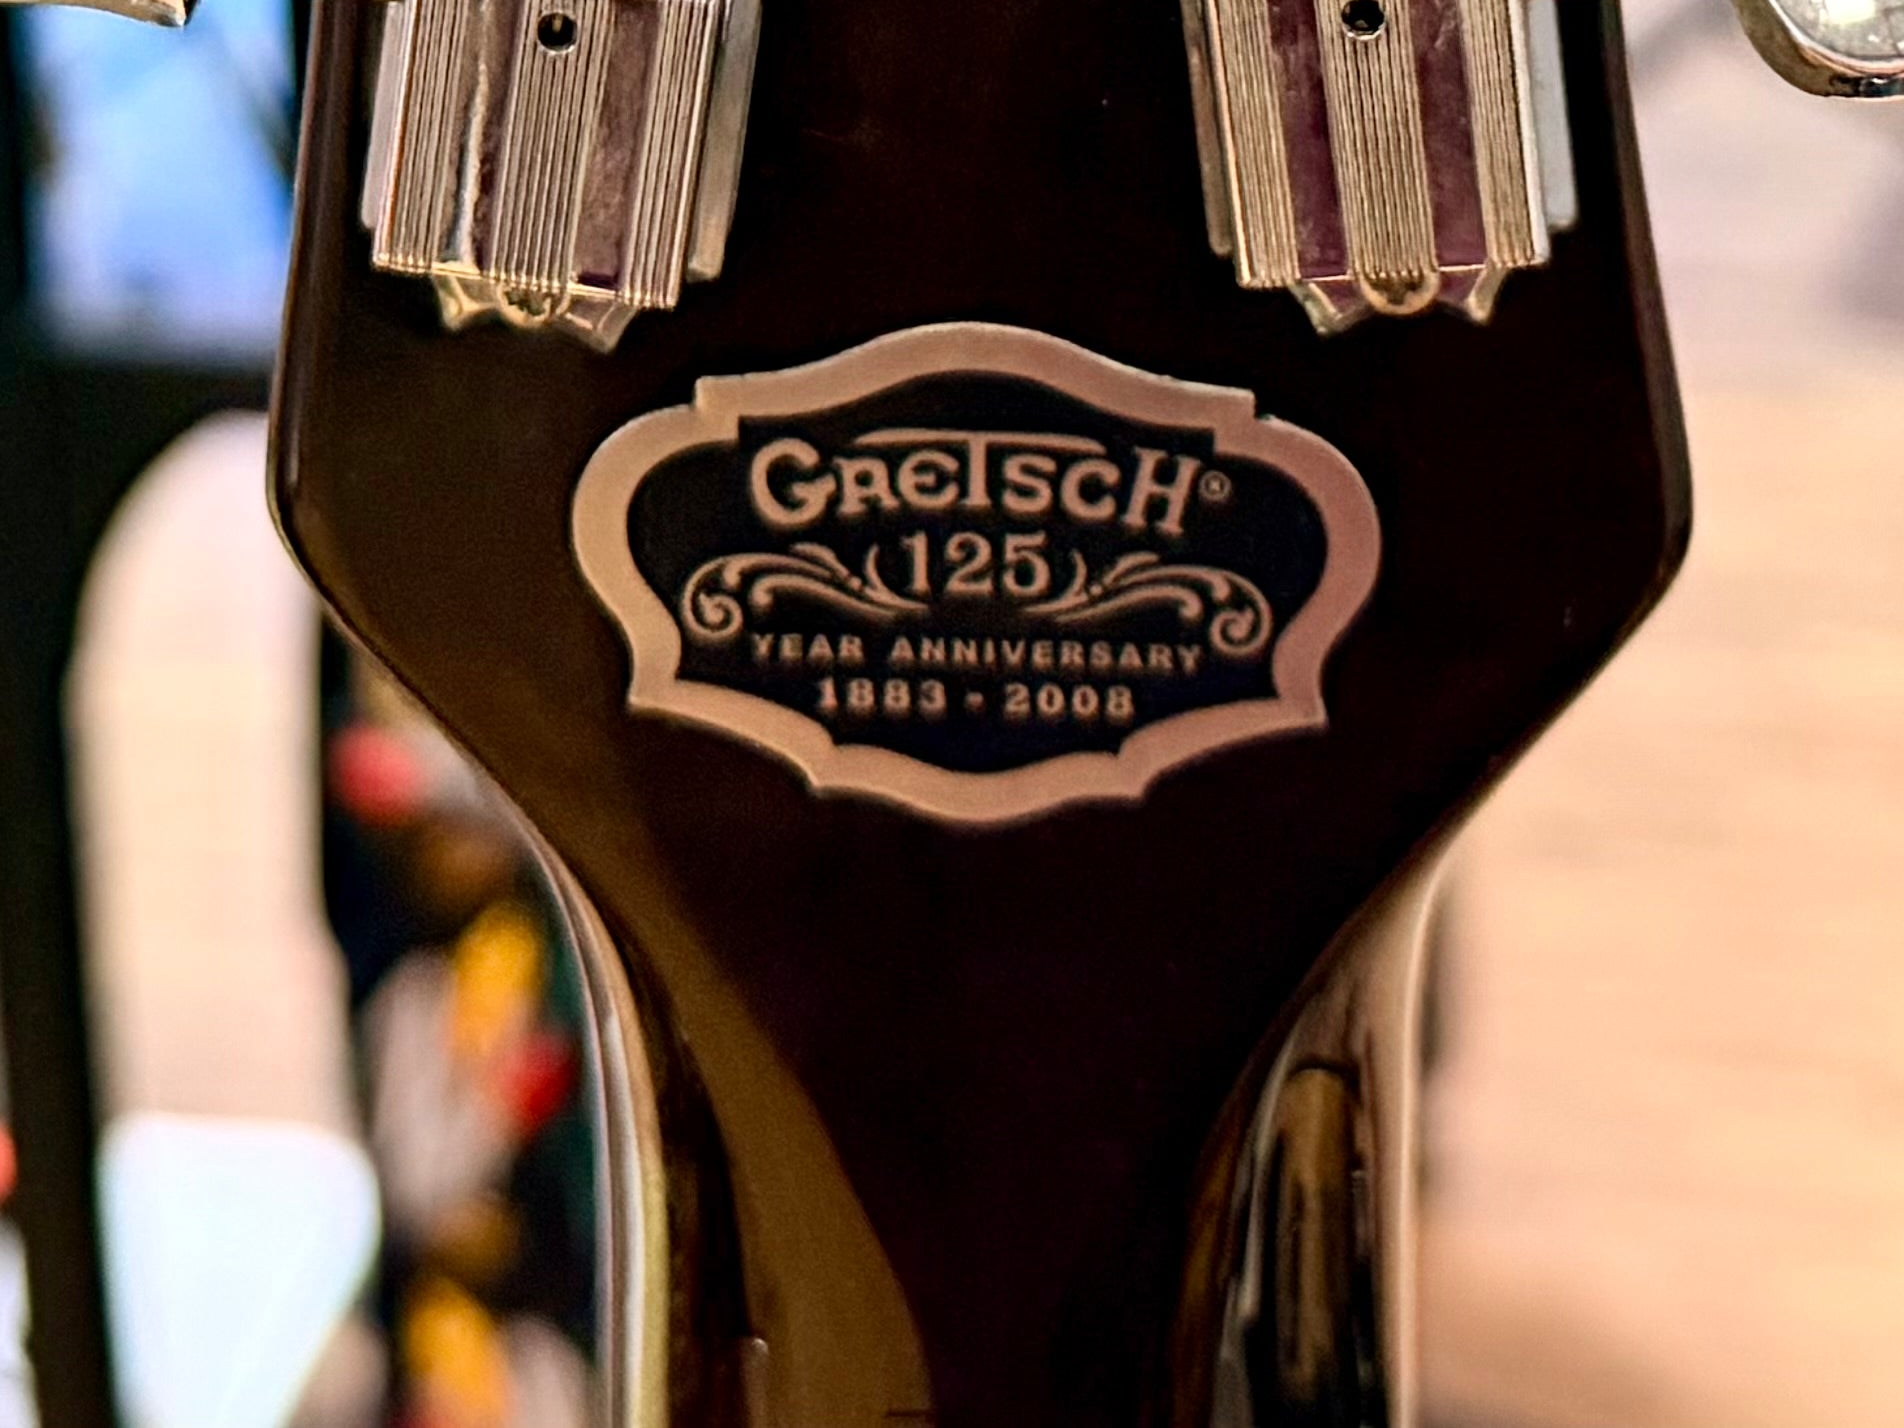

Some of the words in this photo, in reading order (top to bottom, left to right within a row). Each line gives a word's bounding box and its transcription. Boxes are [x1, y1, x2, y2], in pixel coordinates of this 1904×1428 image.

[900, 530, 1052, 597] 125
[753, 634, 864, 661] YEAR
[893, 638, 1202, 673] ANNIVERSARY
[817, 677, 946, 713] 1883
[1004, 682, 1135, 718] 2008
